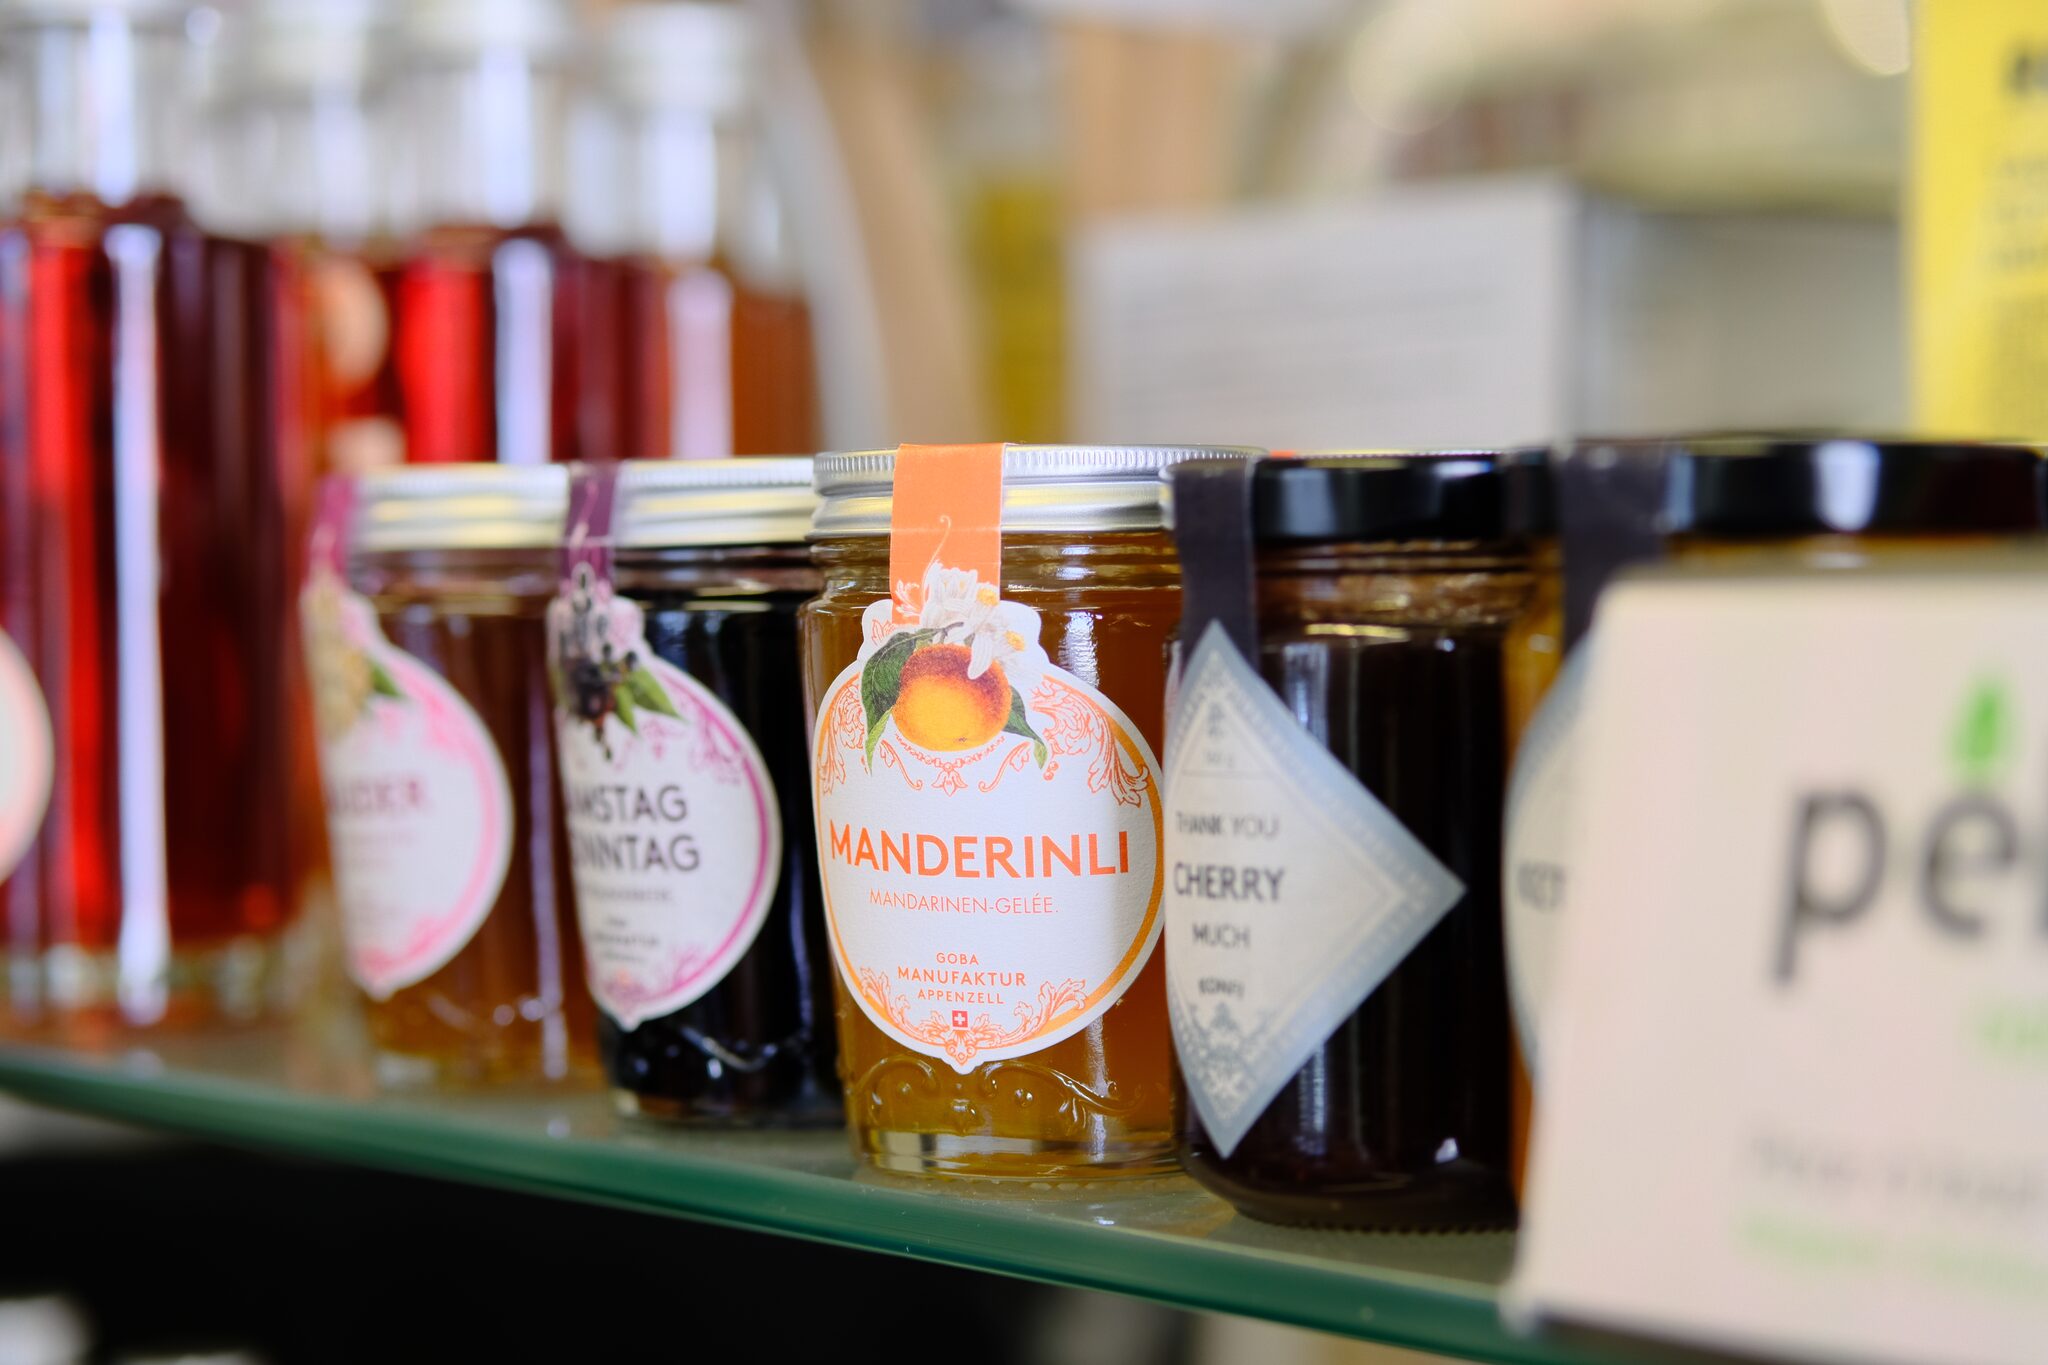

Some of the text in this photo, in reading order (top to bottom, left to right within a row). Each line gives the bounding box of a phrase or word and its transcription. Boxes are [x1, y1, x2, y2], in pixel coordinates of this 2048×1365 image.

[1175, 812, 1279, 839] THANK YOU
[829, 819, 1128, 879] MANDERINLI
[1173, 862, 1285, 902] CHERRY
[869, 888, 1060, 915] MANDARINEN-GELÉE.
[1192, 924, 1250, 949] MUCH
[936, 952, 979, 966] GOBA
[897, 966, 1027, 987] MANUFAKTUR
[918, 988, 1005, 1005] APPENZELL
